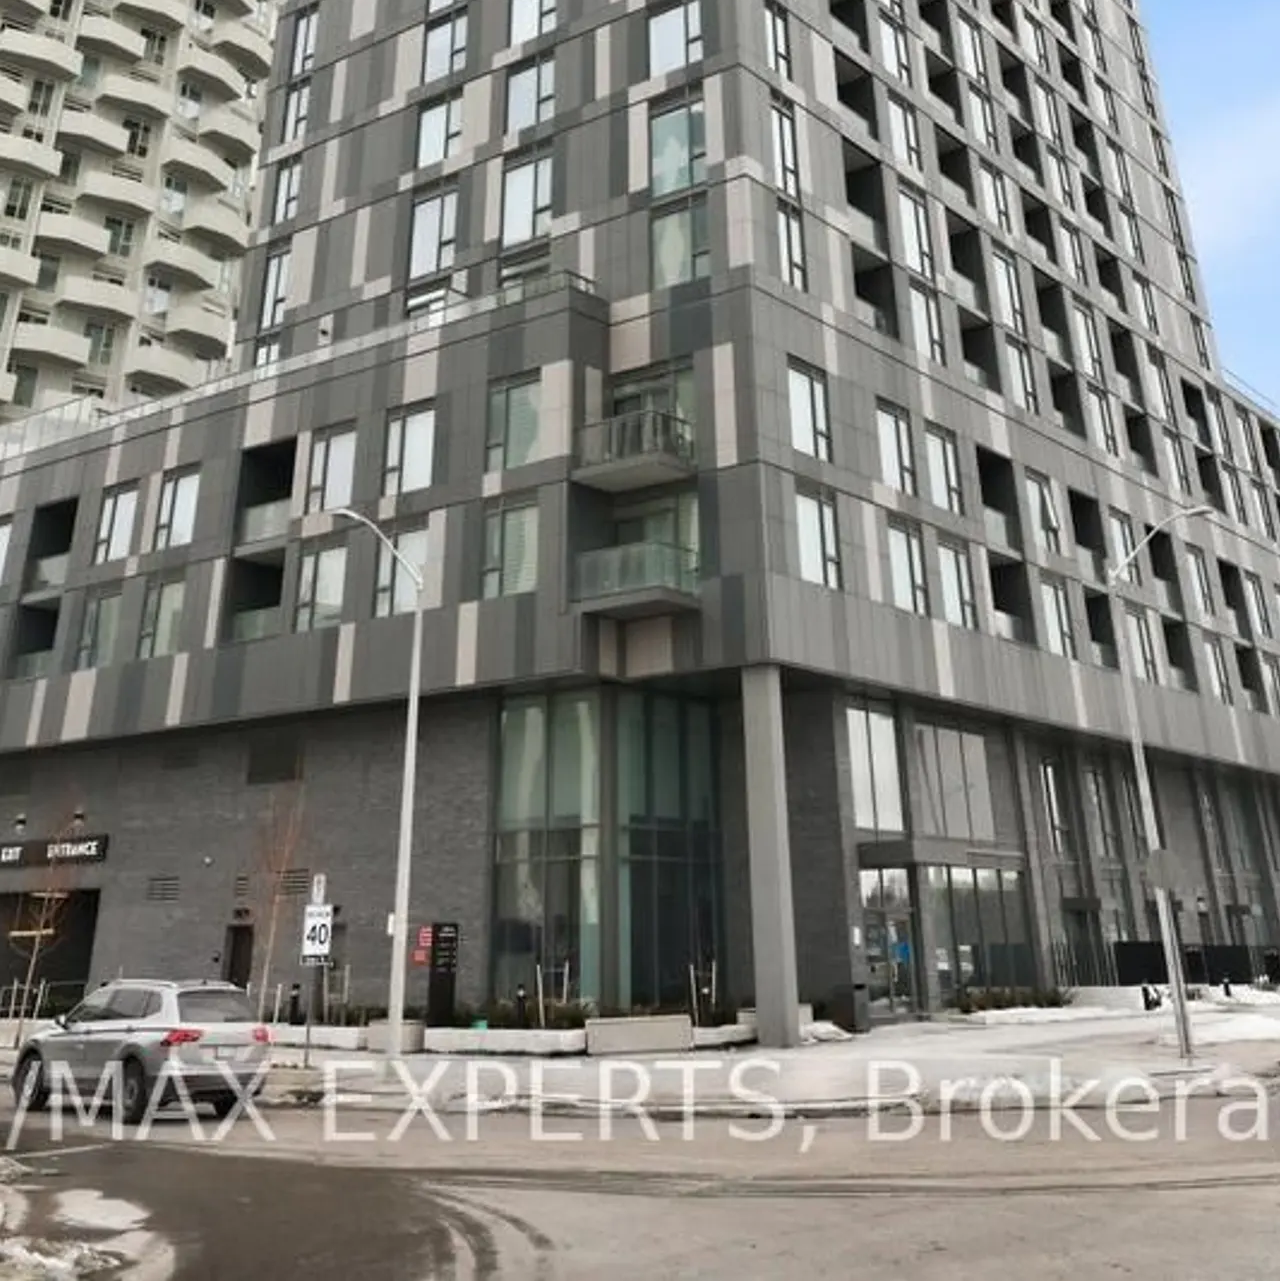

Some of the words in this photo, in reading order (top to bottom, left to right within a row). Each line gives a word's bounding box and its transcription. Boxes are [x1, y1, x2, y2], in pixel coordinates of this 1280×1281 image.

[0, 846, 22, 862] EXIT
[46, 840, 98, 858] ENTRANCE
[306, 923, 329, 946] 40
